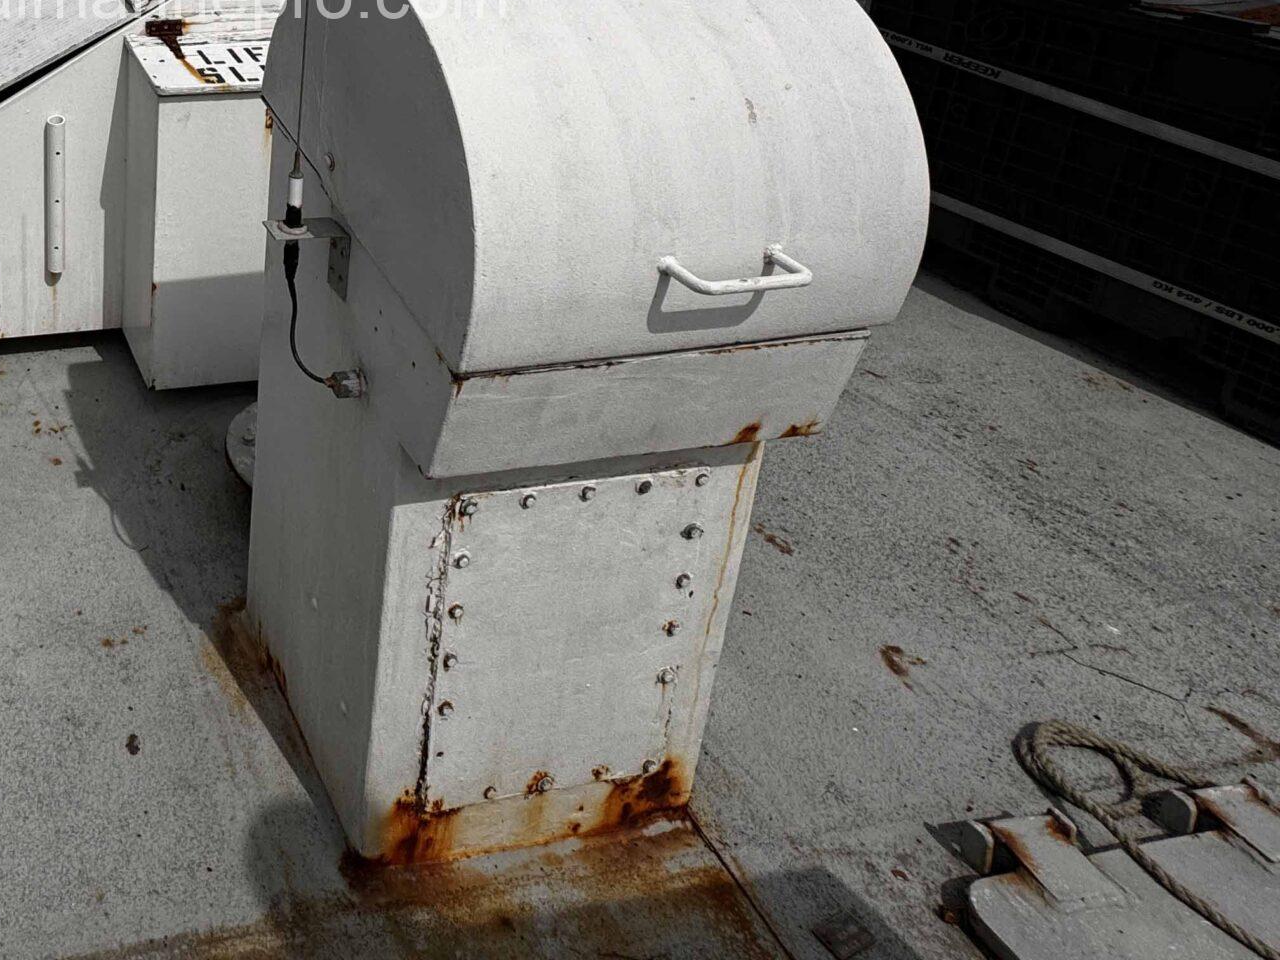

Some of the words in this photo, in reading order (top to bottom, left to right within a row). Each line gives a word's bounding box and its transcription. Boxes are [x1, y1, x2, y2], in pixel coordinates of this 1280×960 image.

[198, 47, 263, 65] LIF
[942, 52, 1001, 79] KEEPER
[1151, 280, 1174, 293] KG
